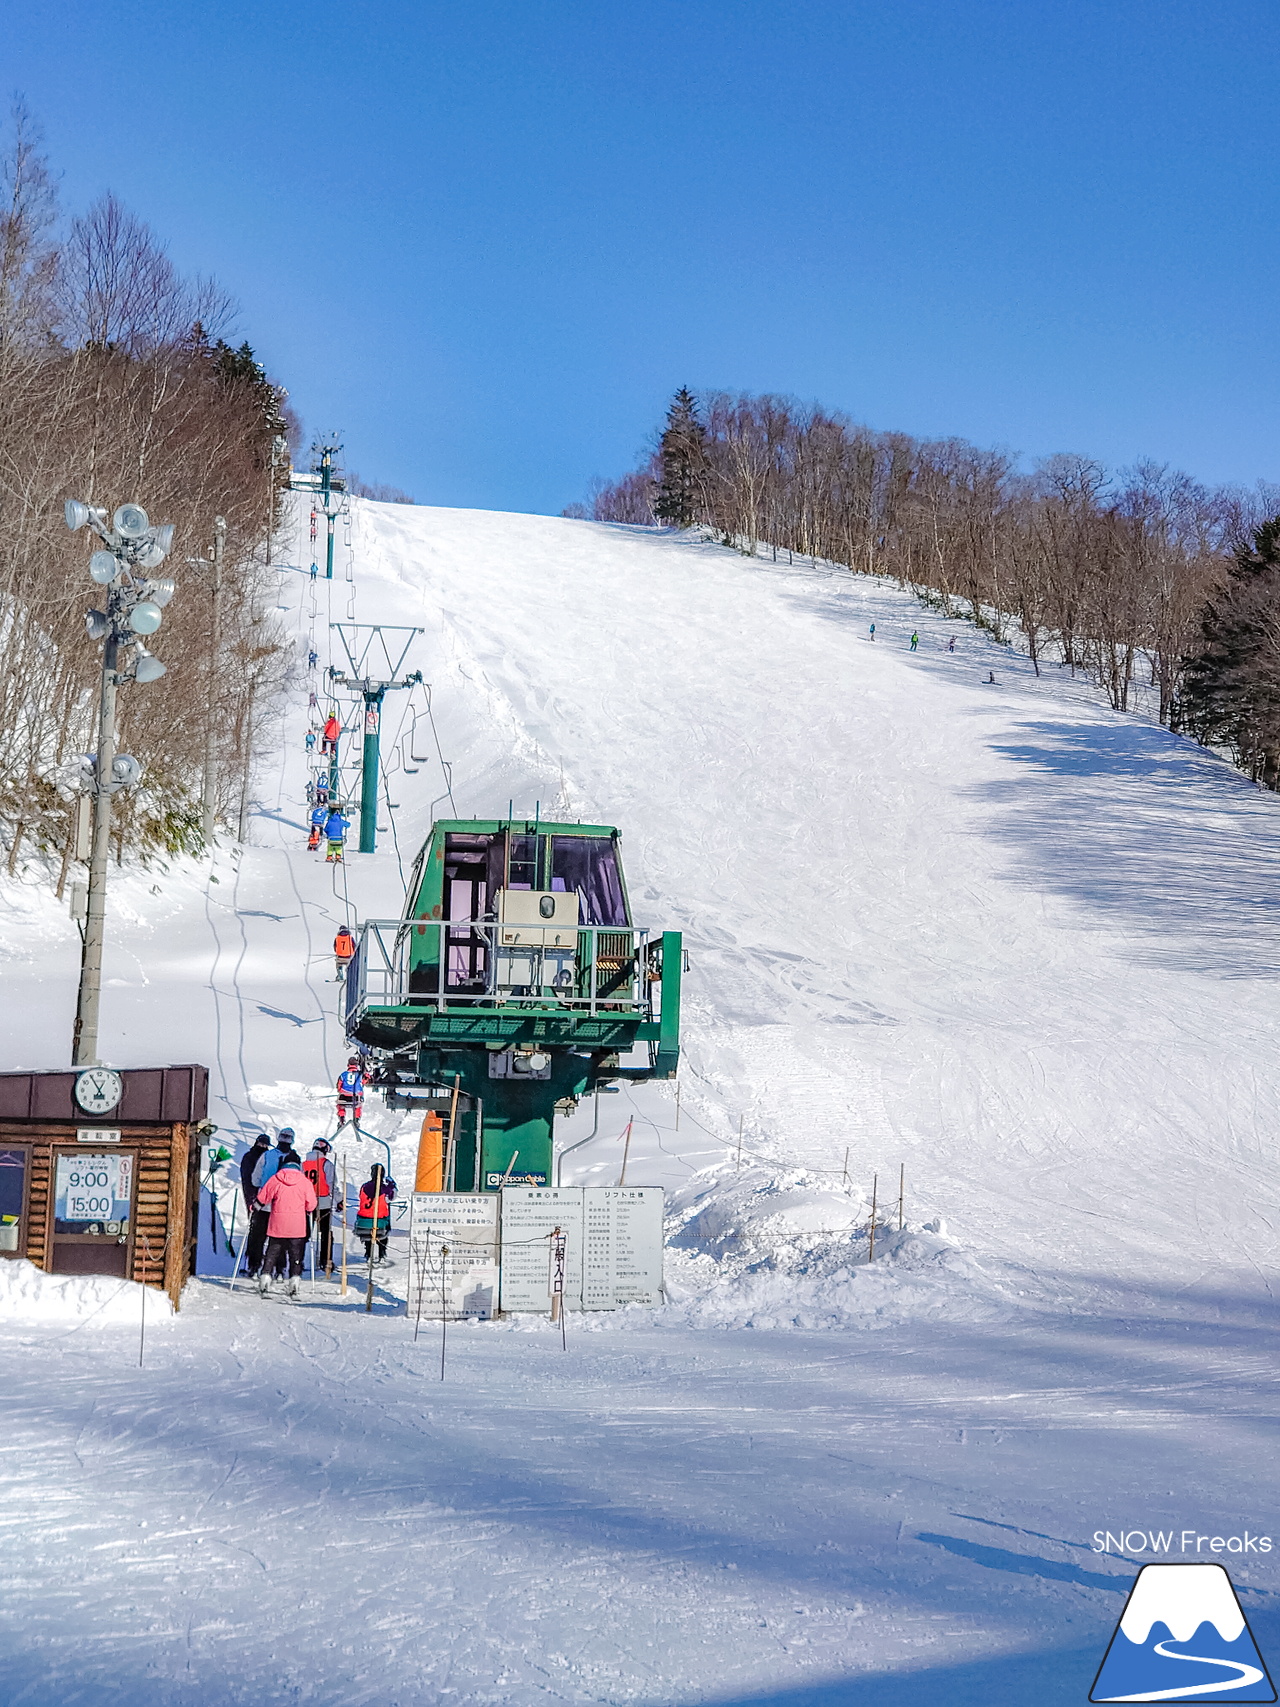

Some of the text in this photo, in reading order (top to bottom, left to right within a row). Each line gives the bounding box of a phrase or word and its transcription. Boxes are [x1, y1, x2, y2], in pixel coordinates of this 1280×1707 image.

[319, 778, 328, 786] 17
[341, 940, 346, 951] 7
[347, 1072, 356, 1085] 9
[70, 1172, 108, 1187] 9:00
[70, 1197, 110, 1212] 15:00
[364, 1198, 374, 1209] 3
